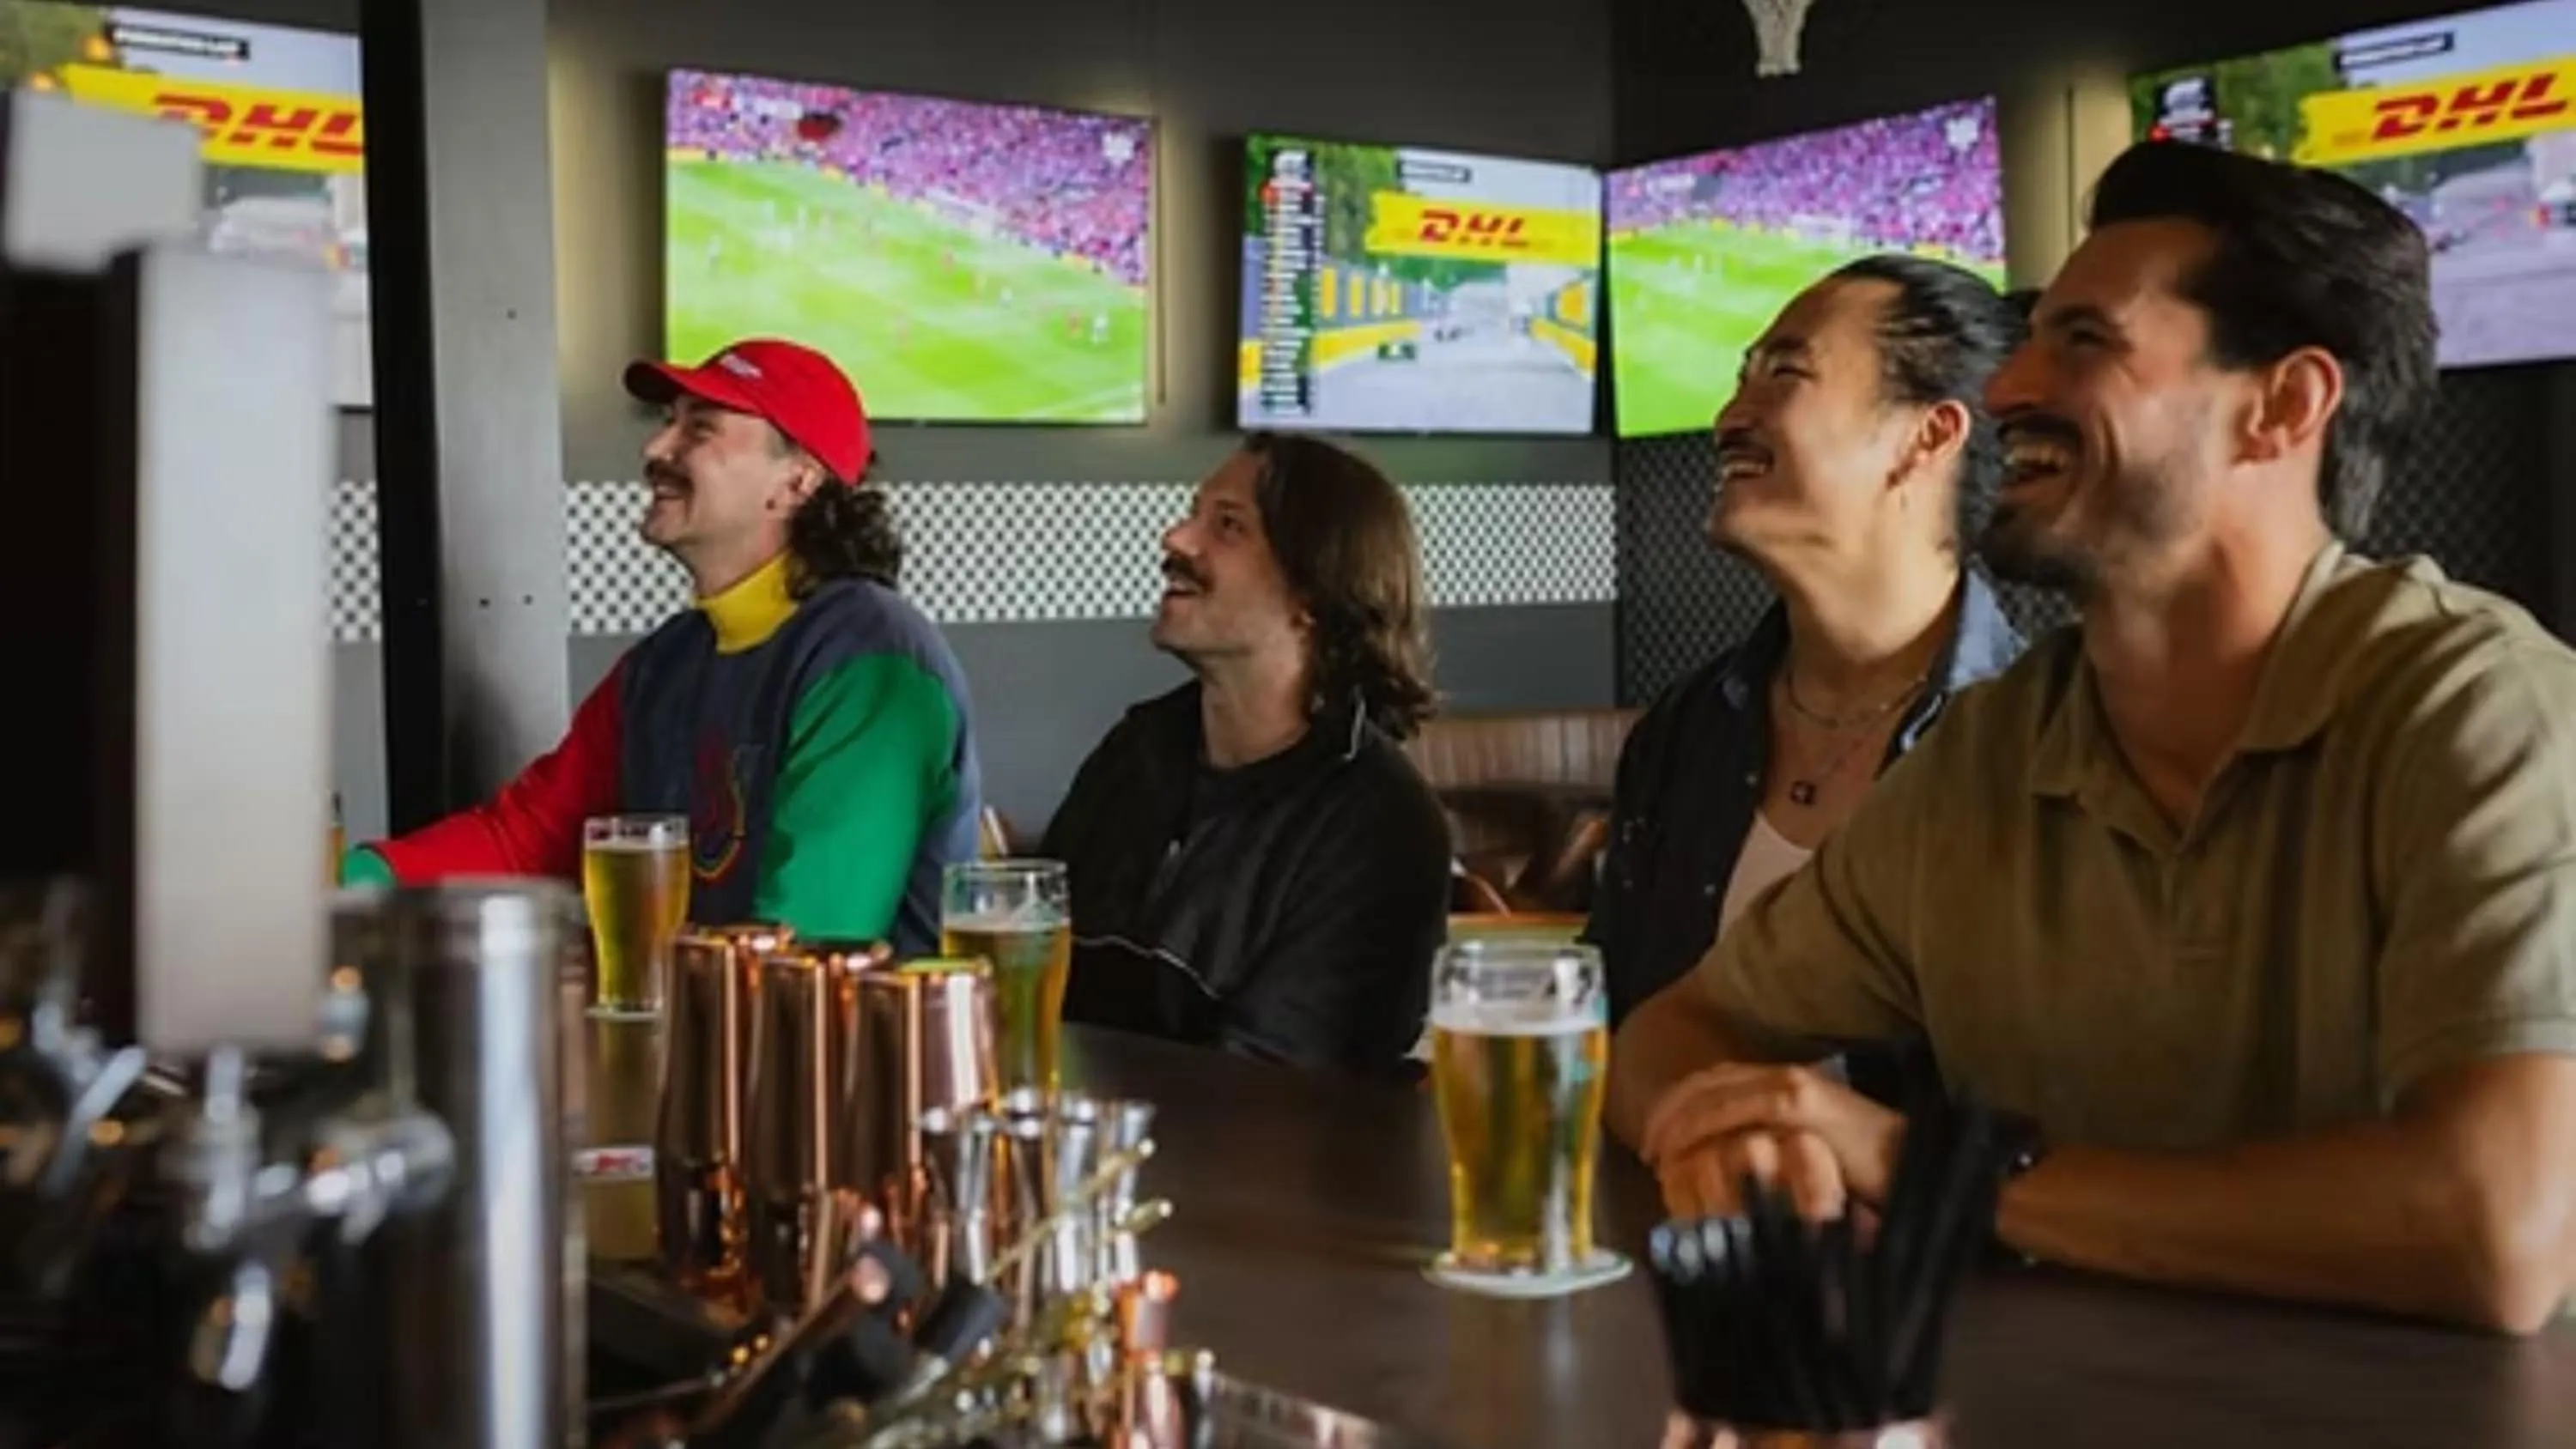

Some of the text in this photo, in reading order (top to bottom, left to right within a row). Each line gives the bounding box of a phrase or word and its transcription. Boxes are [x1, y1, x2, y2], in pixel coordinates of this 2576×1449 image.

[154, 93, 362, 155] DHL
[2372, 73, 2567, 142] DHL
[1419, 209, 1528, 248] DHL
